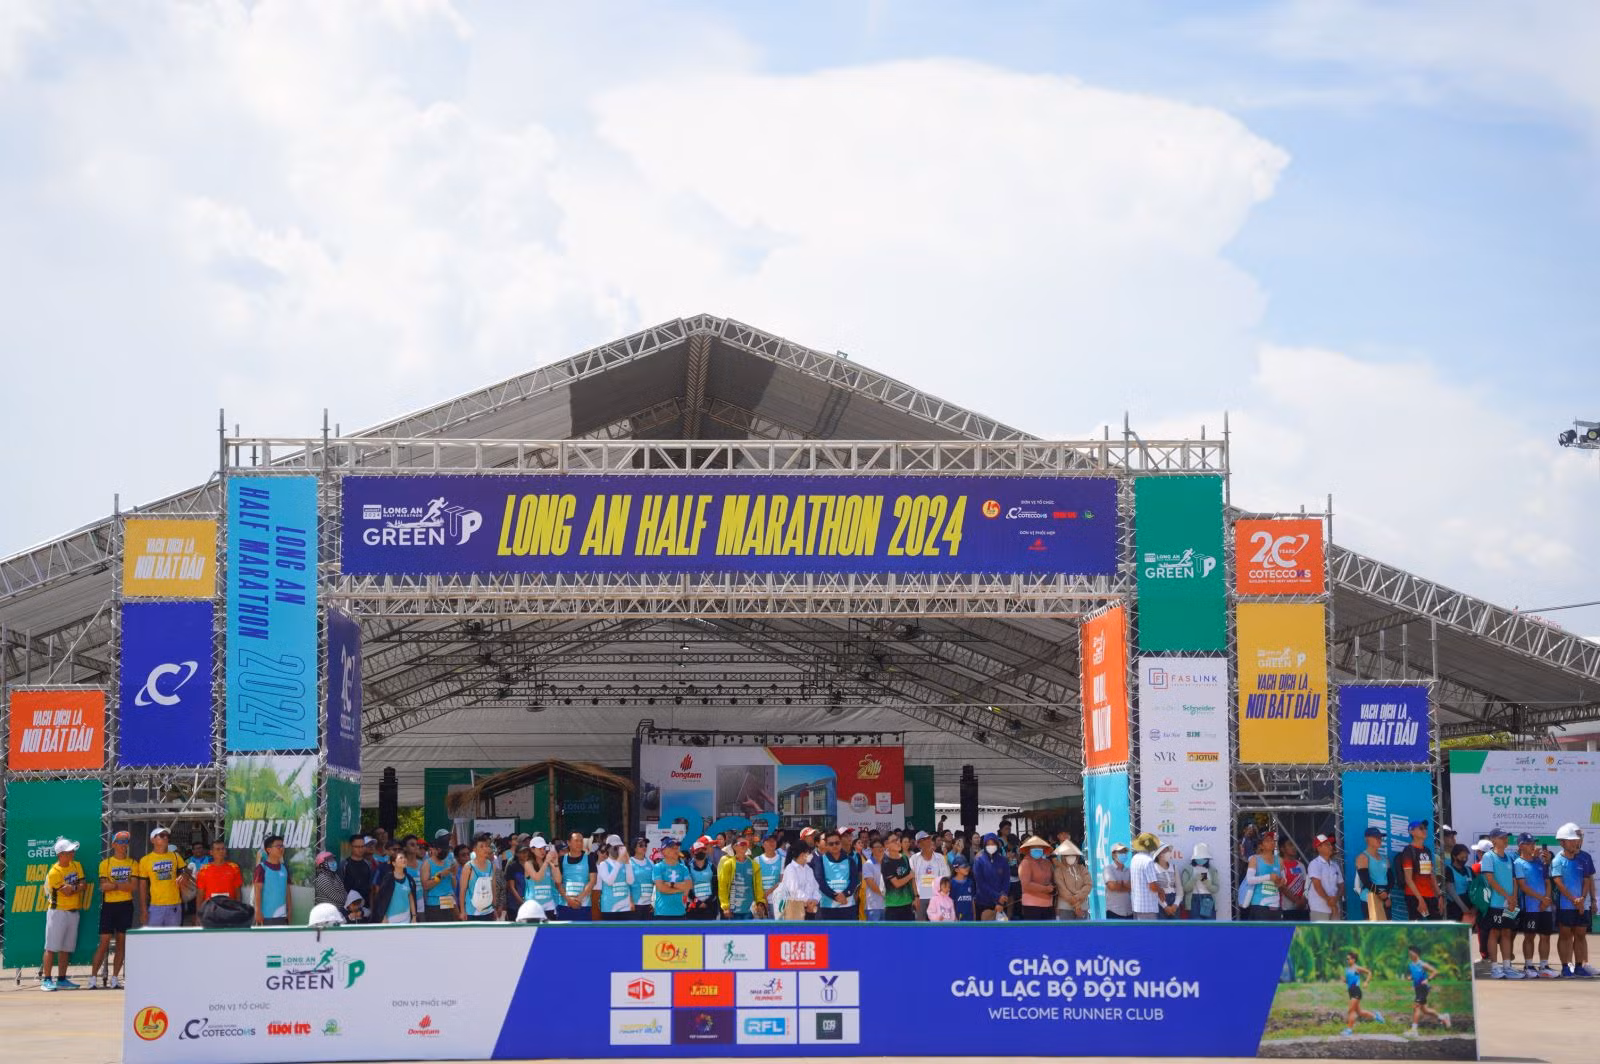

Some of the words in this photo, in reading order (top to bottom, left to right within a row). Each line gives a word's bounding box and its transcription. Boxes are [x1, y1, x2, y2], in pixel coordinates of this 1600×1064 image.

[239, 486, 270, 532] HALF
[497, 494, 577, 556] LONG
[579, 494, 633, 556] AN
[634, 494, 713, 556] HALF
[715, 494, 884, 556] MARATHON
[887, 494, 968, 556] 2024
[363, 528, 445, 546] GREEN
[276, 526, 306, 571] LONG
[1145, 567, 1194, 579] GREEN
[238, 538, 270, 640] MARATHON
[275, 578, 306, 606] AN
[238, 649, 306, 741] 2024
[1154, 752, 1177, 761] SVR
[1481, 785, 1513, 797] LỊCH
[1517, 782, 1559, 795] TRÌNH
[1367, 794, 1386, 817] HALF
[1493, 795, 1511, 808] SỰ
[1514, 794, 1548, 809] KIỆN
[28, 850, 57, 858] GREE
[1493, 915, 1502, 923] 93
[1527, 920, 1536, 929] 62
[1009, 955, 1069, 976] CHÀO
[1075, 955, 1141, 976] MỪNG
[266, 974, 334, 990] GREEN
[951, 976, 994, 998] CÂU
[1001, 980, 1041, 1002] LẠC
[1047, 976, 1078, 1002] BỘ
[1084, 976, 1127, 1002] ĐỘI
[1134, 976, 1200, 998] NHÓM
[989, 1007, 1059, 1020] WELCOME
[1063, 1007, 1123, 1021] RUNNER
[1126, 1008, 1164, 1021] CLUB
[748, 1021, 784, 1033] RFL
